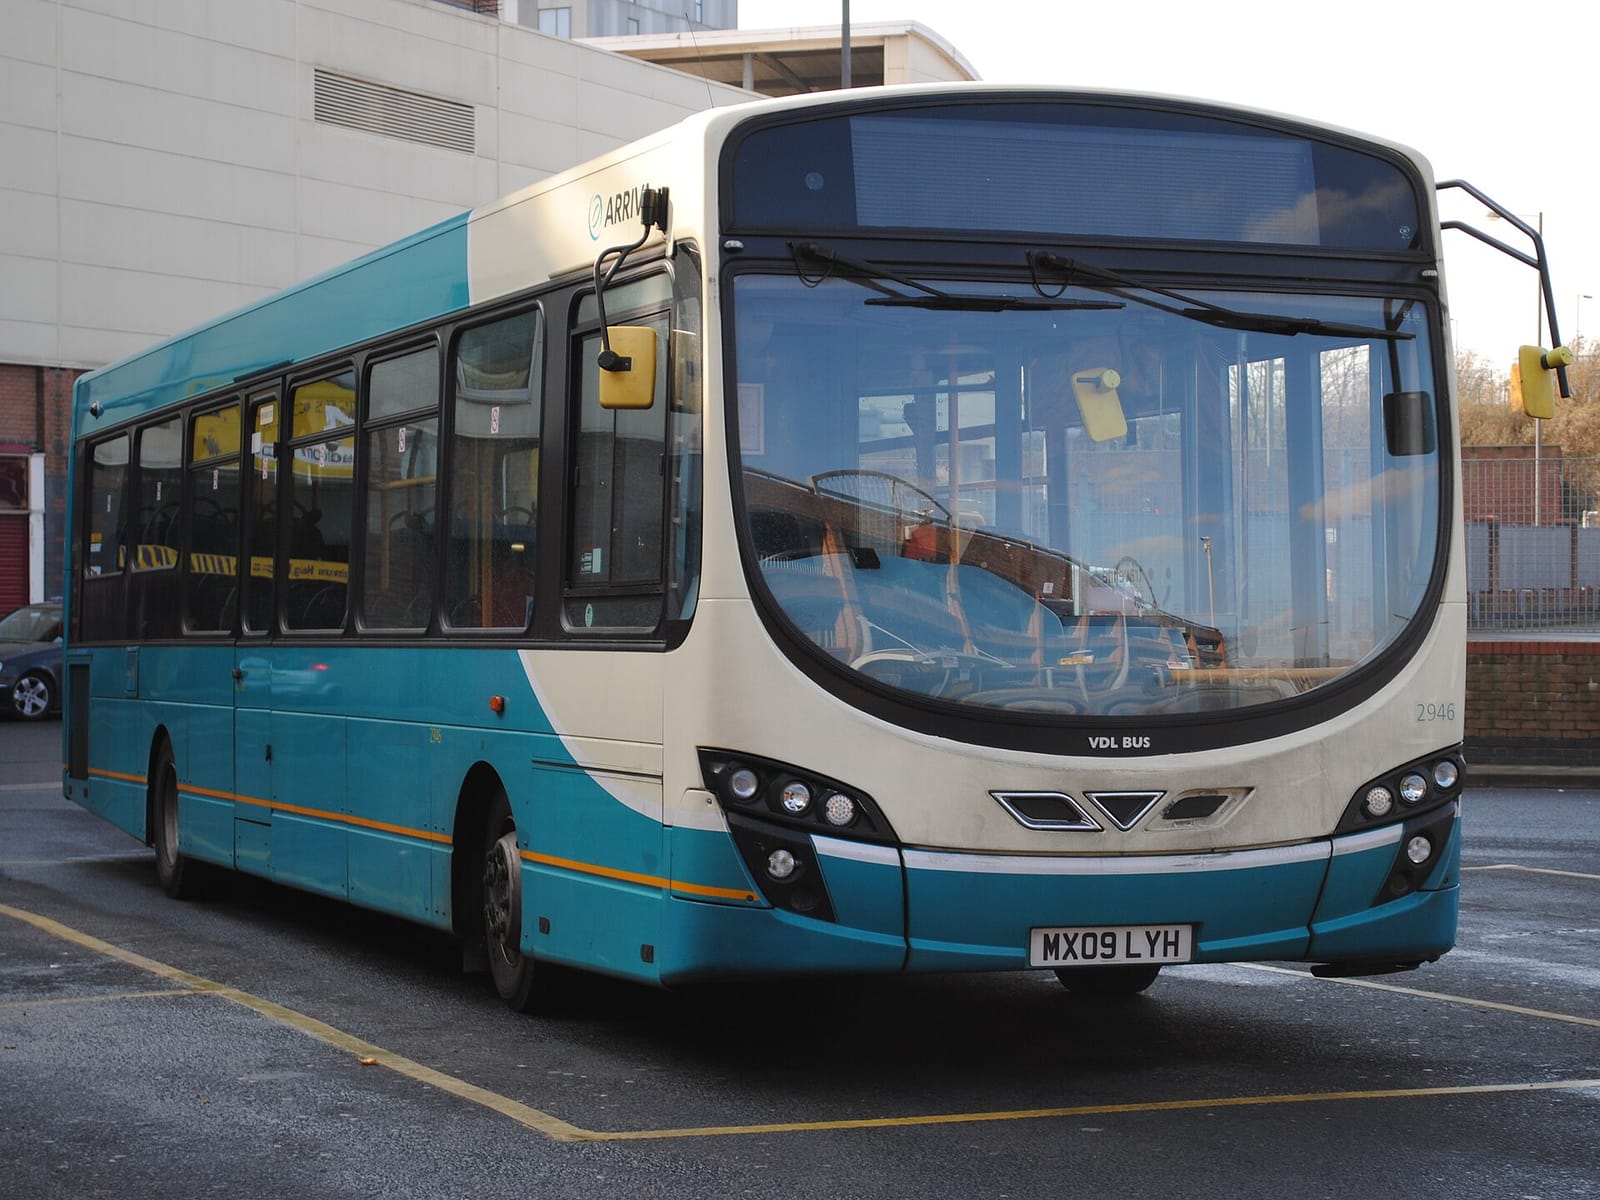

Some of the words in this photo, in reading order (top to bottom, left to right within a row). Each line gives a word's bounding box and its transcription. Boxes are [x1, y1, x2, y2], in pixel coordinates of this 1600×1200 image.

[604, 183, 650, 228] ARRIV
[1416, 703, 1456, 722] 2946
[1088, 736, 1118, 749] VDL
[1122, 736, 1151, 749] BUS
[1043, 931, 1117, 961] MX09
[1125, 930, 1177, 958] LYH
